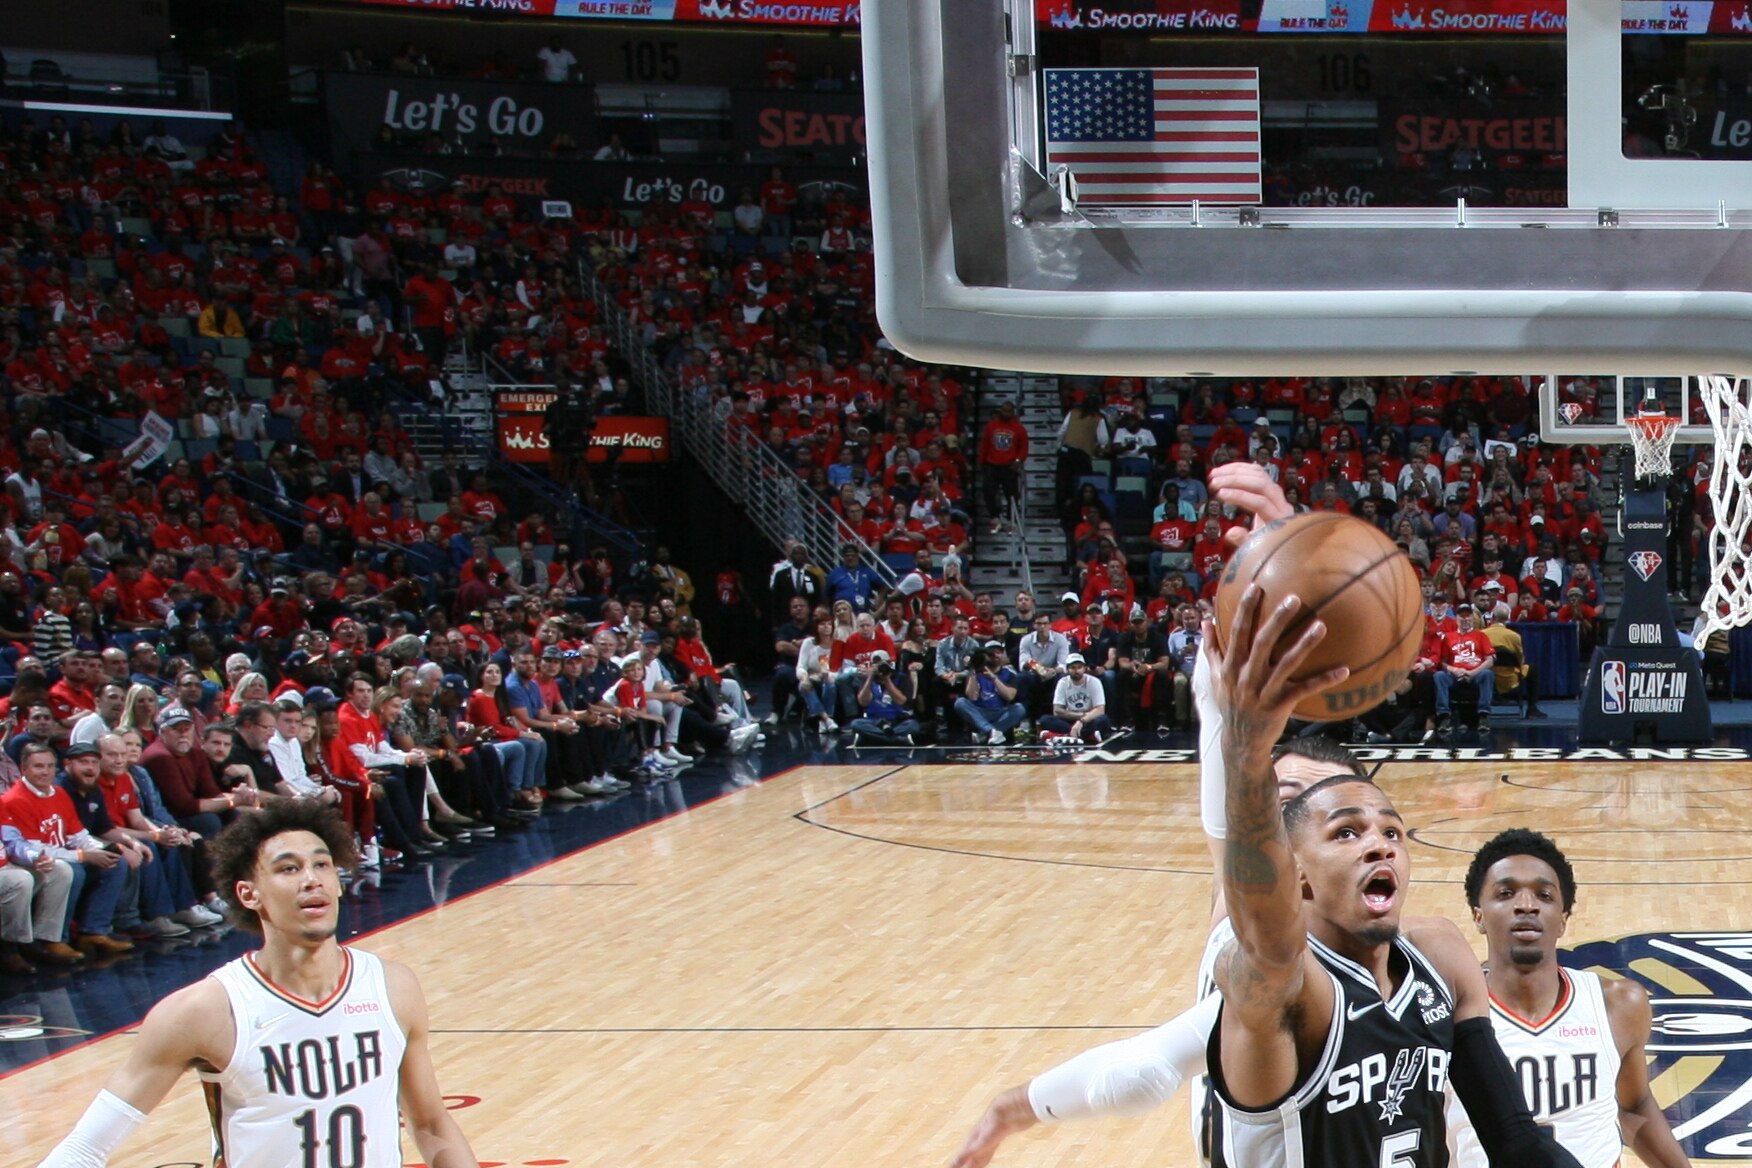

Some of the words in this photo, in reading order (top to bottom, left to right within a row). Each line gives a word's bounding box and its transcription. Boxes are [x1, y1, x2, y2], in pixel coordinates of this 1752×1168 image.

[609, 3, 630, 15] THE
[739, 0, 839, 23] SMOOTHIE
[1087, 8, 1186, 28] SMOOTHIE
[1429, 8, 1526, 29] SMOOTHIE
[620, 40, 681, 83] 105
[1316, 53, 1371, 93] 106
[384, 89, 478, 134] Let's
[488, 96, 544, 136] Go
[1627, 521, 1664, 530] coinbase
[1628, 623, 1662, 644] @NBA
[1628, 672, 1687, 698] PLAY-IN
[1628, 698, 1685, 713] TOURNAMENT
[342, 1001, 380, 1015] ibotta
[1557, 1025, 1597, 1038] ibotta
[259, 1029, 383, 1100] NOLA
[1326, 1046, 1452, 1126] SPUR
[1515, 1053, 1598, 1117] OLA
